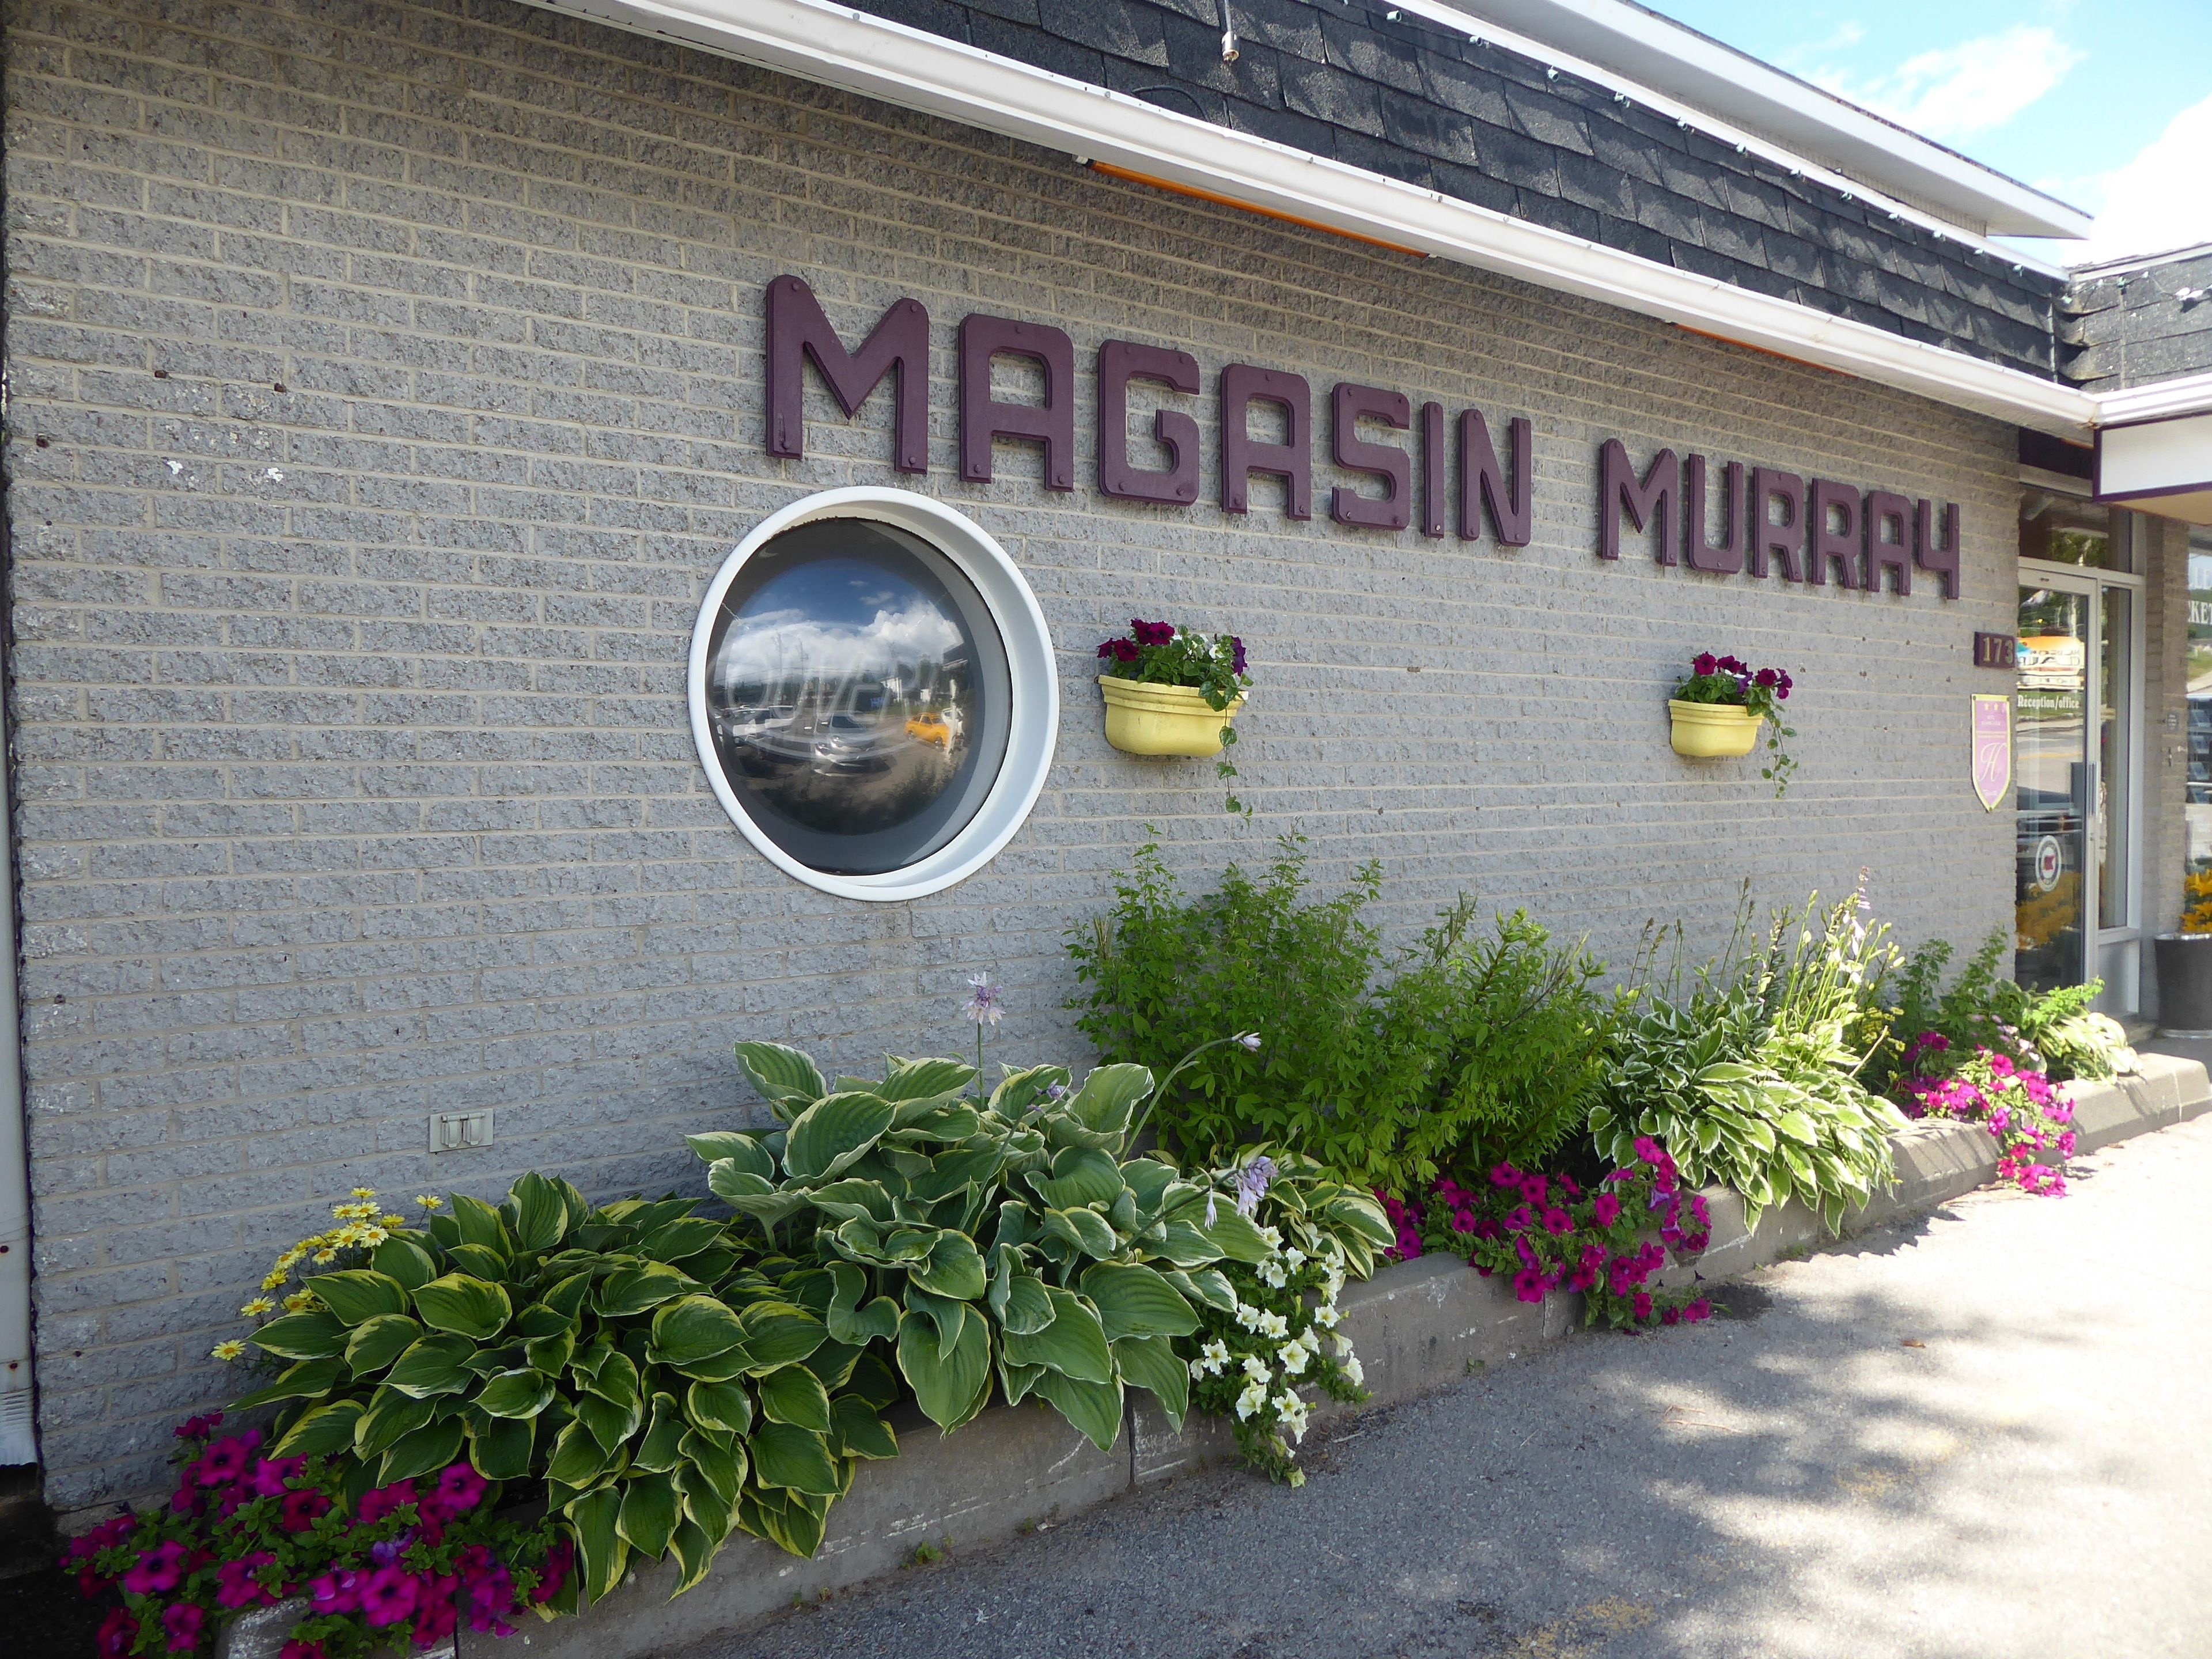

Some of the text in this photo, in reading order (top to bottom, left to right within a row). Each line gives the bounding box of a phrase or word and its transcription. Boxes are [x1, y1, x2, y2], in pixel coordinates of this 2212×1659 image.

[766, 274, 1959, 600] MAGASIN MURRAY
[1983, 637, 2013, 664] 173
[2017, 695, 2080, 710] Réception/office
